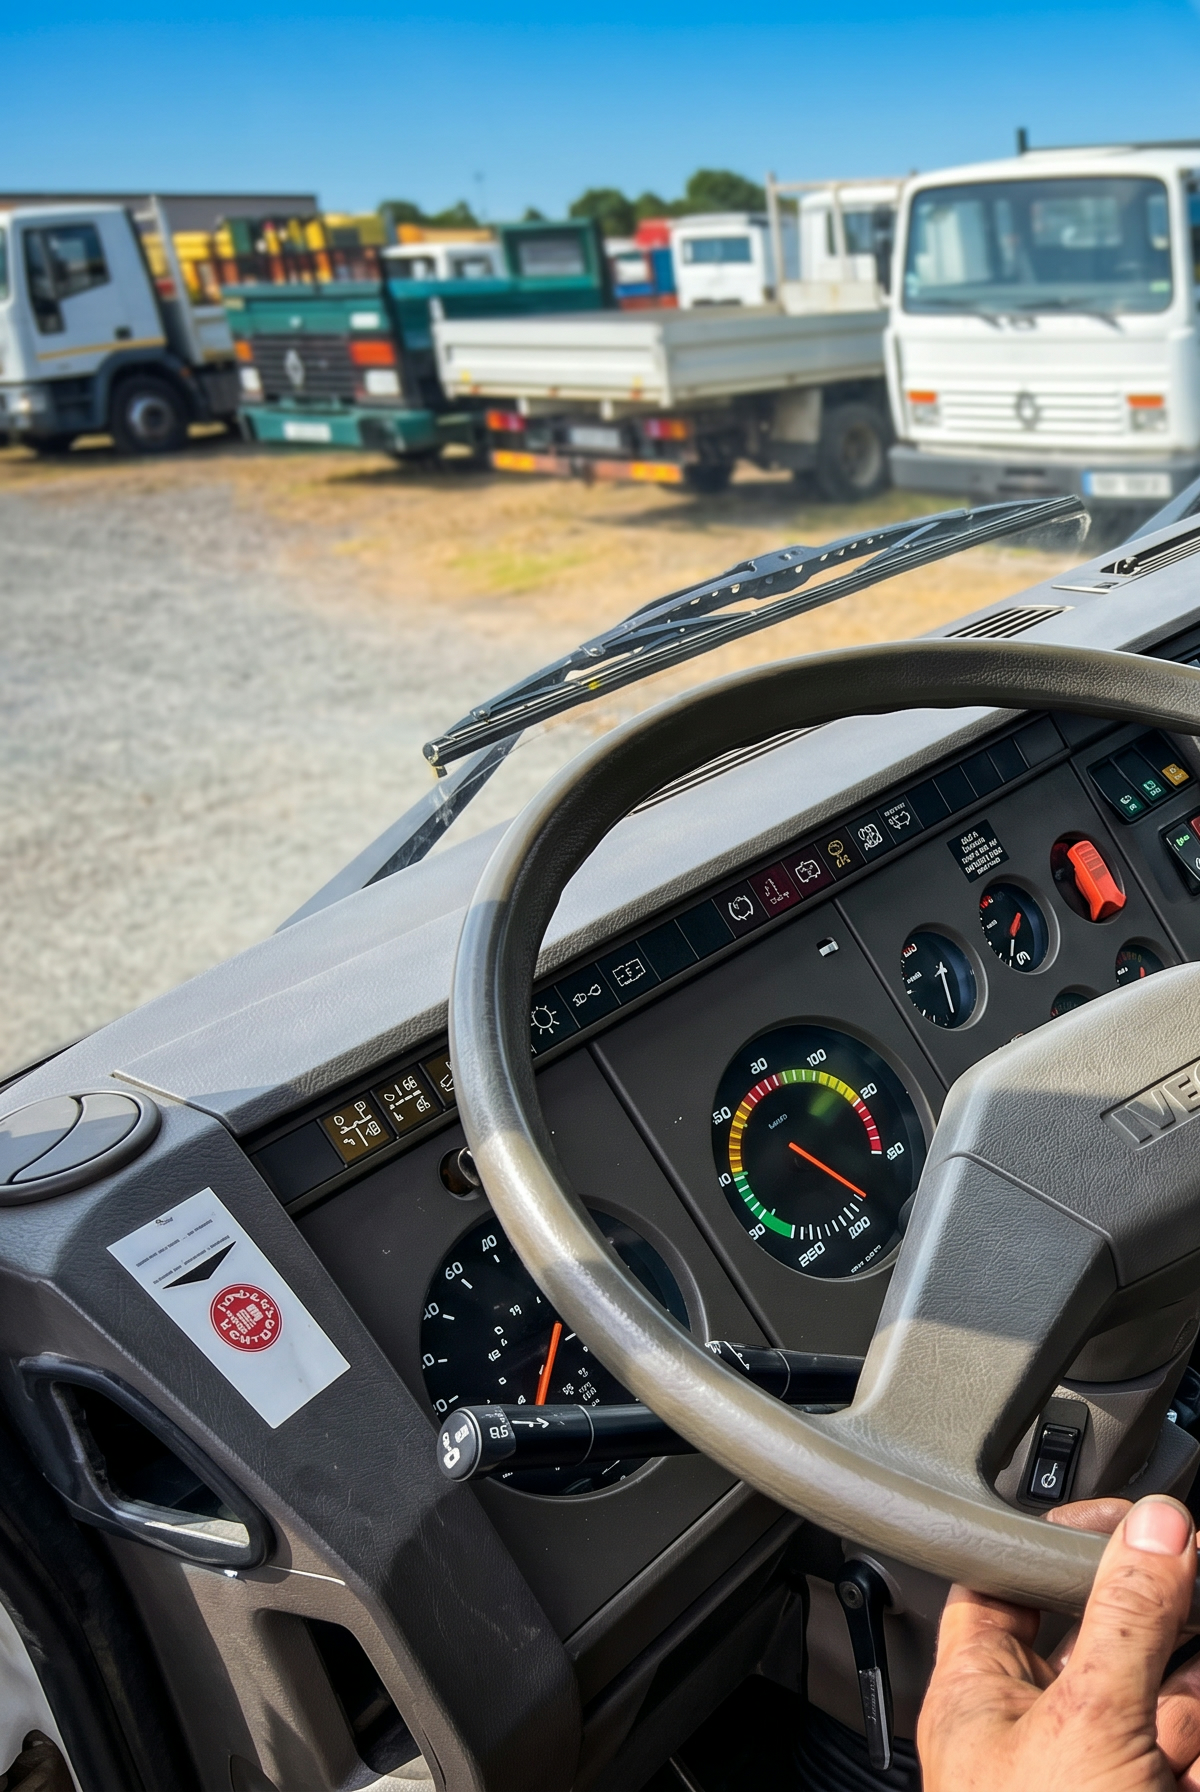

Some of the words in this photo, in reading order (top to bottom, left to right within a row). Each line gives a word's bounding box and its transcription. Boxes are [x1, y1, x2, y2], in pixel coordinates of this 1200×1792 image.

[806, 1049, 827, 1067] 100
[860, 1082, 877, 1099] 20
[445, 1261, 463, 1280] 60
